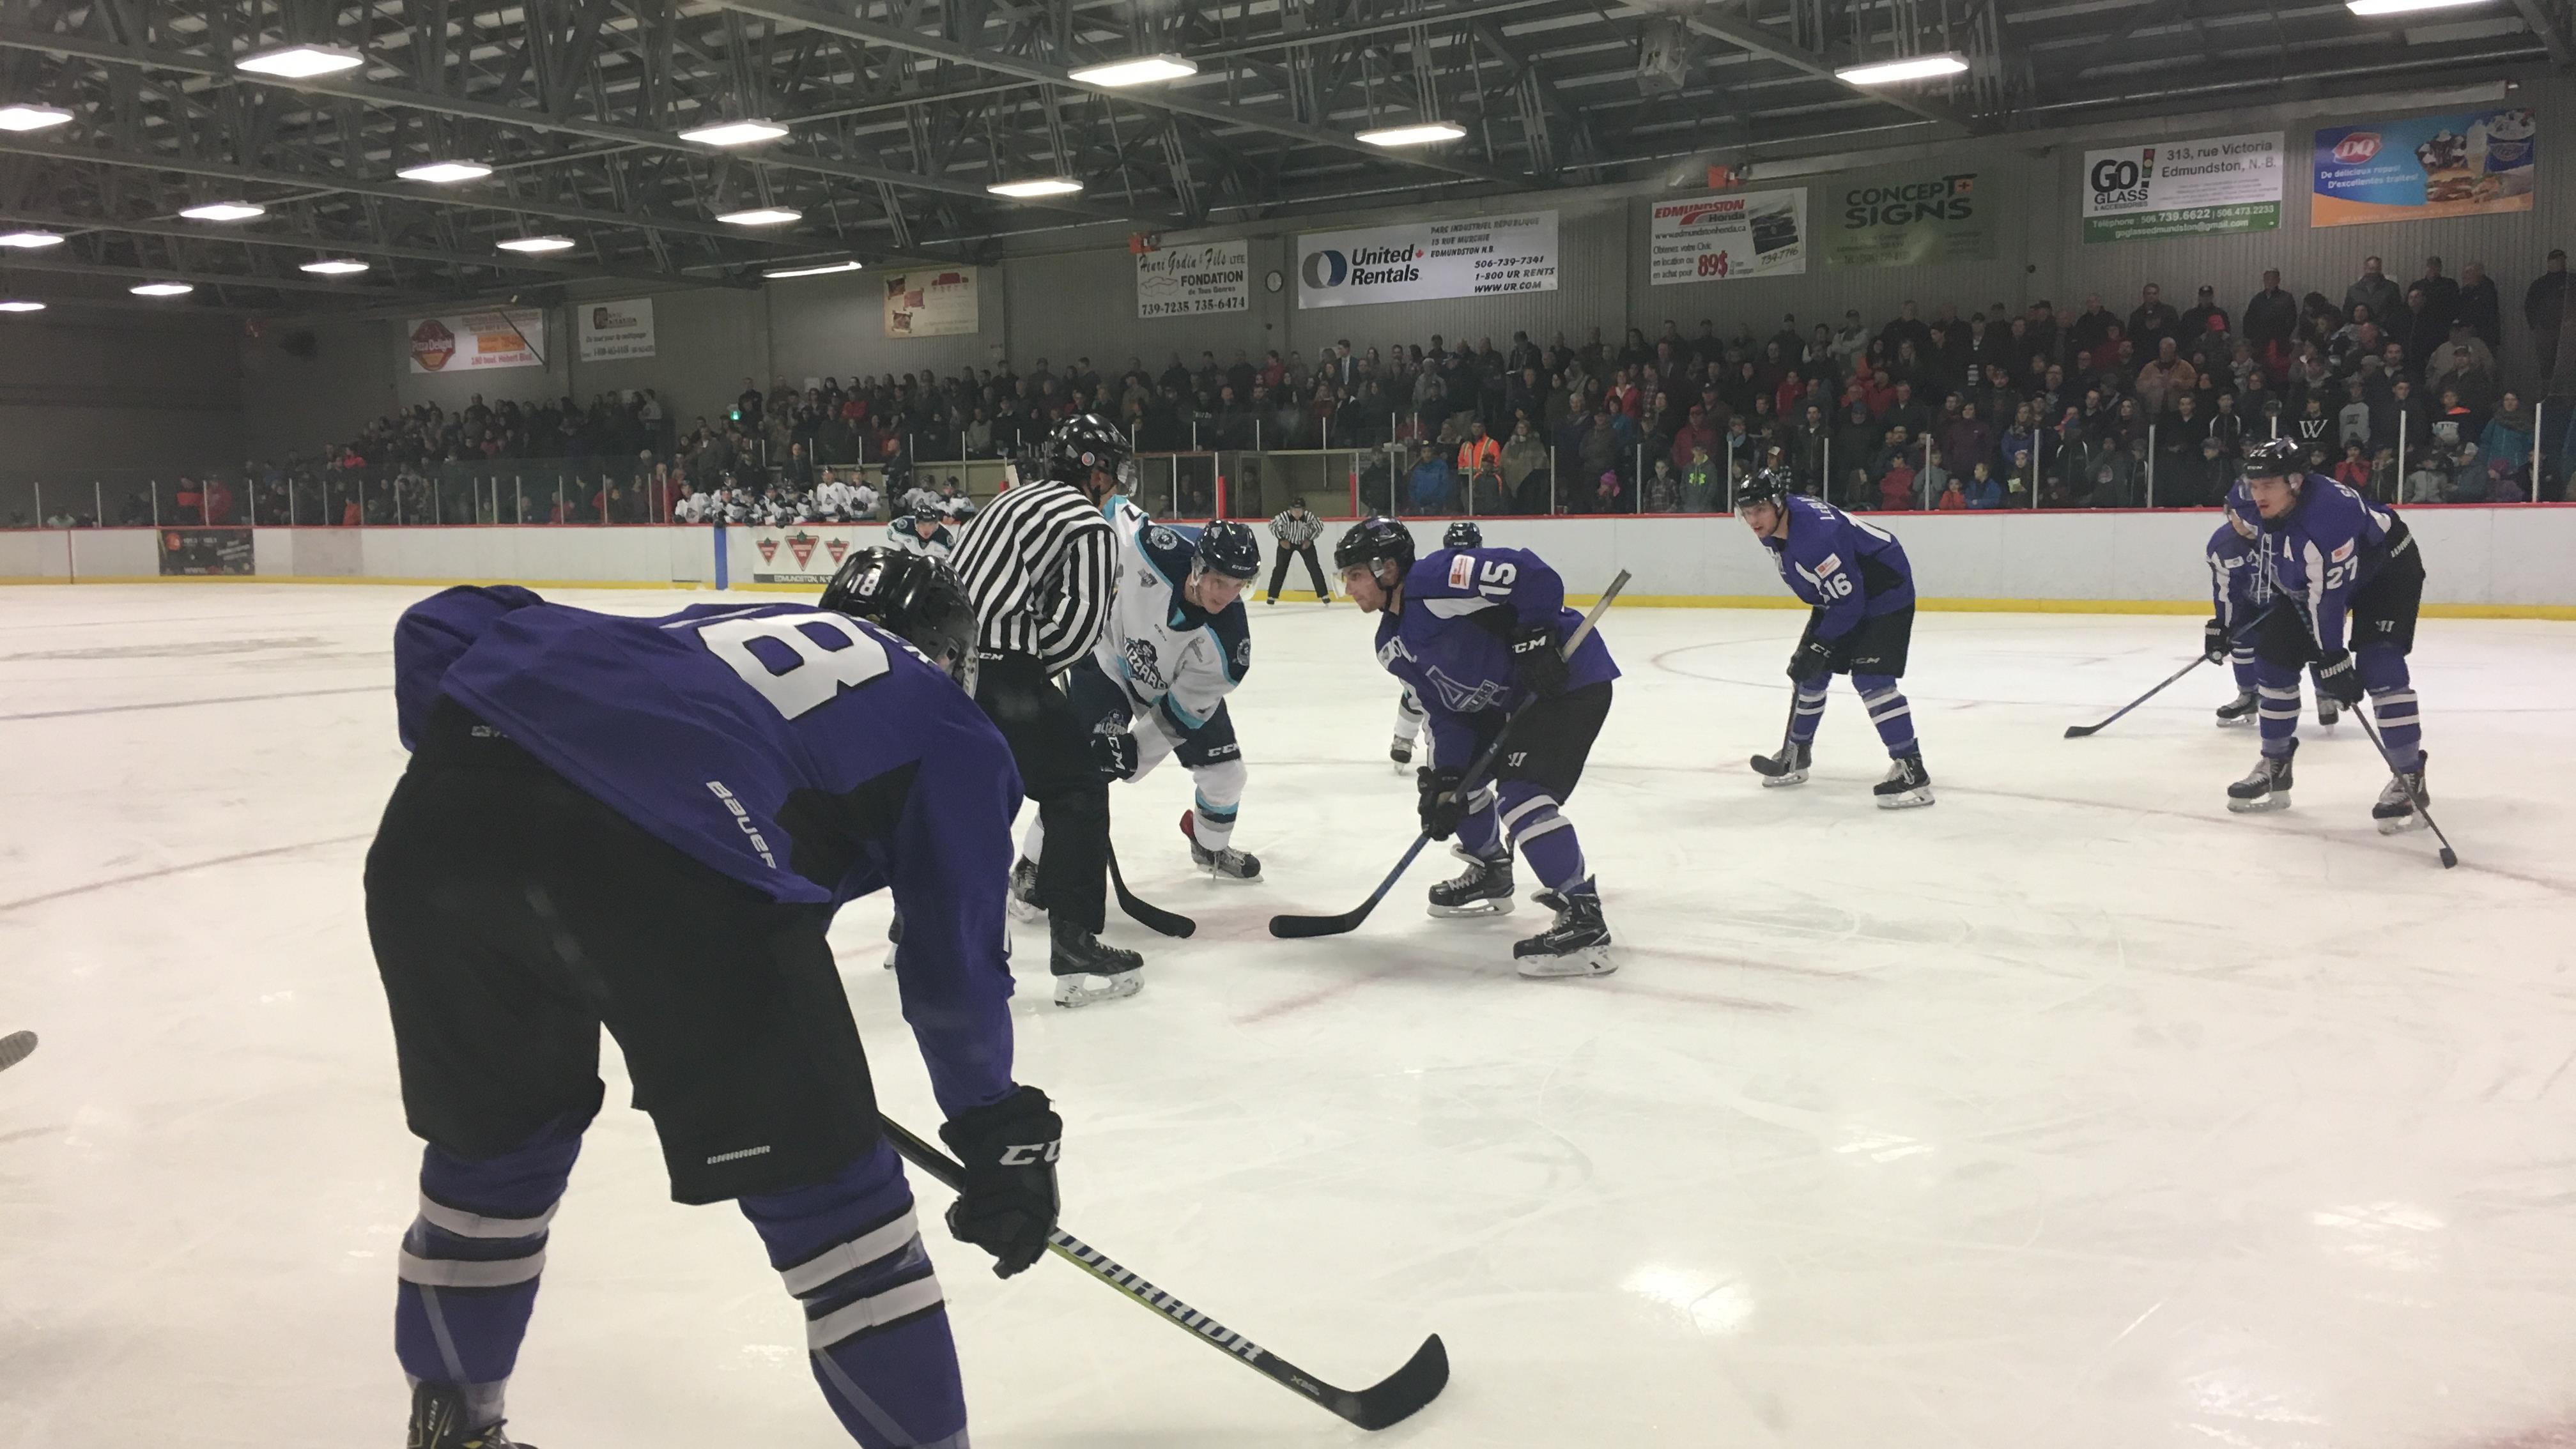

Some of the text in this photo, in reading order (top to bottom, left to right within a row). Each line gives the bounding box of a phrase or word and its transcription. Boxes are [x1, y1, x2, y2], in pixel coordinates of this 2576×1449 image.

[2167, 141, 2272, 161] 313, rue Victoria
[2341, 141, 2377, 157] DQ
[2162, 161, 2246, 178] Edmundston,
[1846, 173, 1977, 206] CONCEPT
[2094, 188, 2148, 205] GLASS
[1844, 197, 1973, 229] SIGNS
[2100, 201, 2148, 211] ACCESSORIES
[1708, 211, 1745, 223] Honda
[1431, 225, 1448, 234] PARC
[1450, 222, 1492, 233] INDUSTRIEL
[1442, 236, 1456, 245] RUE
[1457, 234, 1490, 243] MURCHIE
[1205, 248, 1226, 270] Fils
[1352, 243, 1414, 266] United
[1430, 247, 1479, 258] EDMUNDSTON
[1475, 266, 1555, 281] 1-800 UR RENTS
[1697, 250, 1728, 278] 89$
[1181, 270, 1244, 287] FONDATION
[1351, 264, 1419, 286] Rentals
[1679, 270, 1692, 279] pour
[429, 339, 452, 353] Delight
[2299, 419, 2328, 439] W
[2284, 535, 2294, 562] A
[847, 567, 879, 596] 18
[1478, 560, 1517, 597] 15
[2326, 555, 2358, 590] 27
[1824, 572, 1853, 599] 16
[1512, 636, 1546, 654] CM
[1050, 1228, 1263, 1363] WARRIOR
